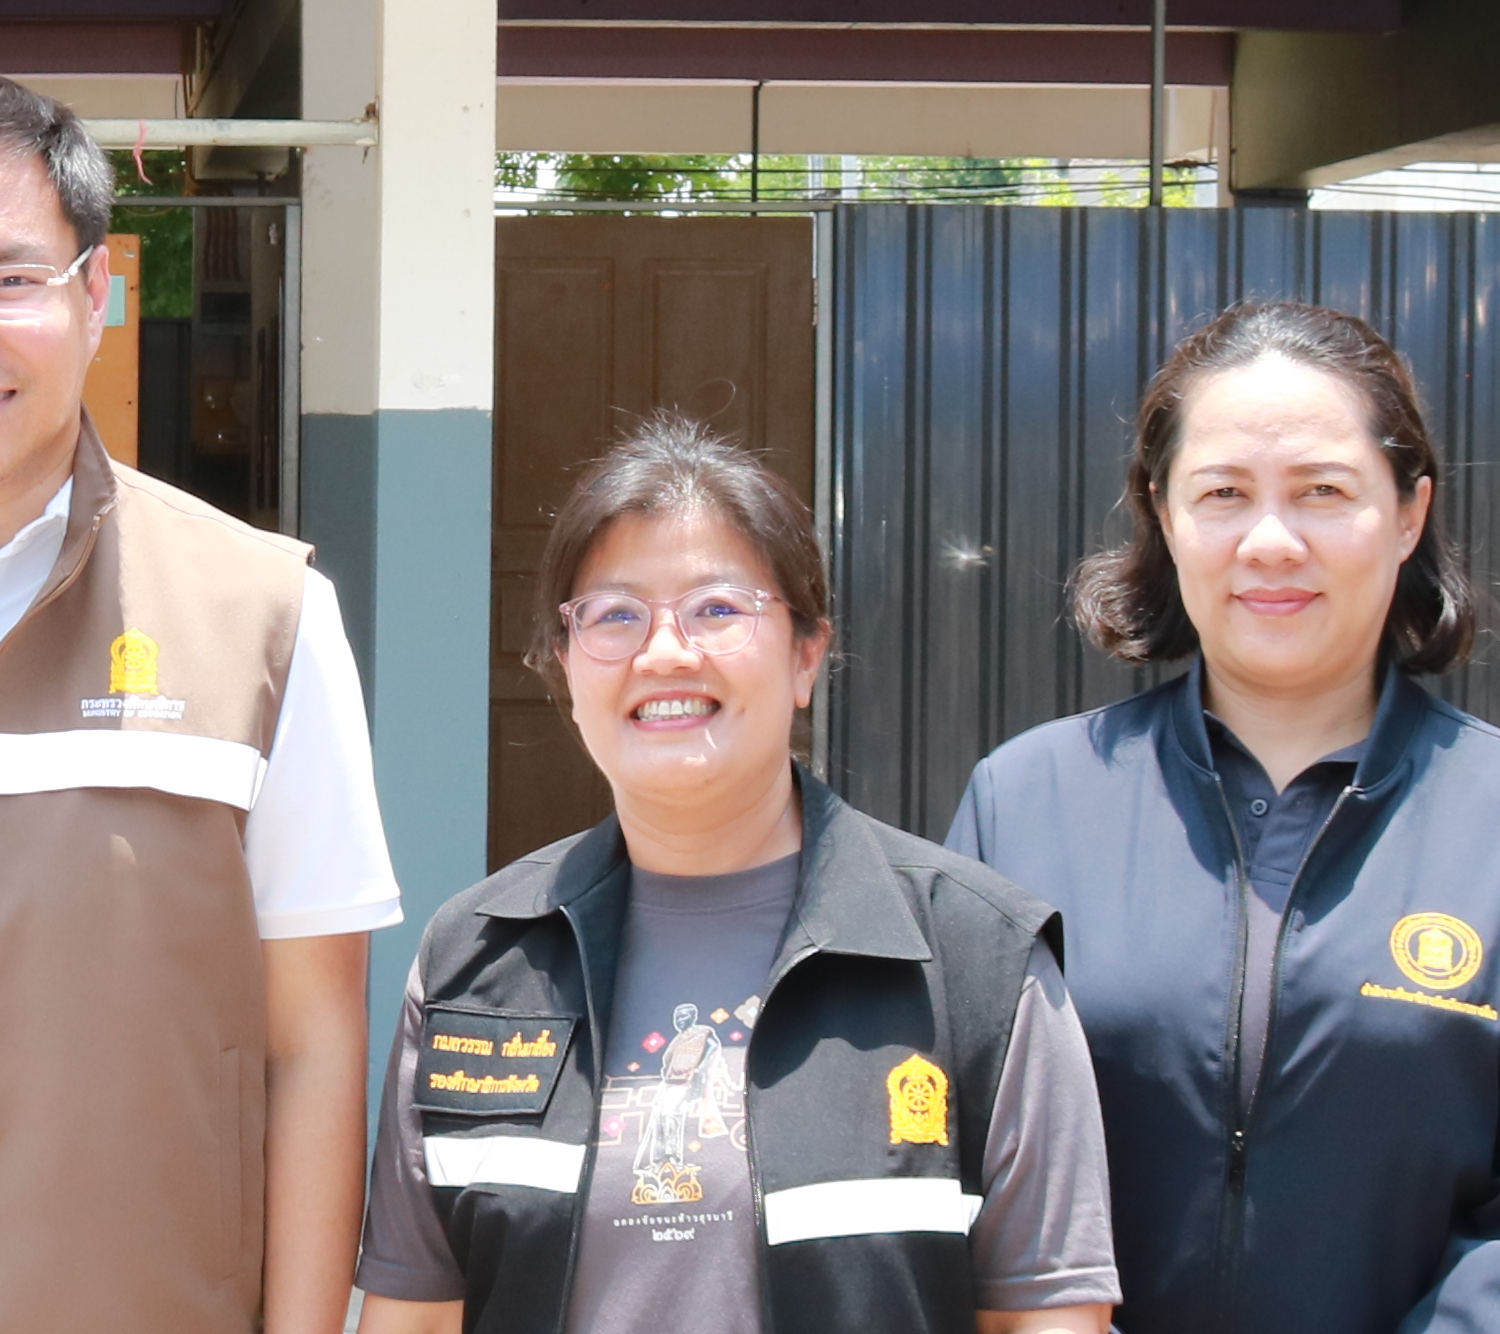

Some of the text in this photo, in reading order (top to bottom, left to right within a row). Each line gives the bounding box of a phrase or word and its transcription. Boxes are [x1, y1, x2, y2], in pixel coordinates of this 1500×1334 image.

[429, 1069, 541, 1094] รองศึกษาธิการจังหวัด
